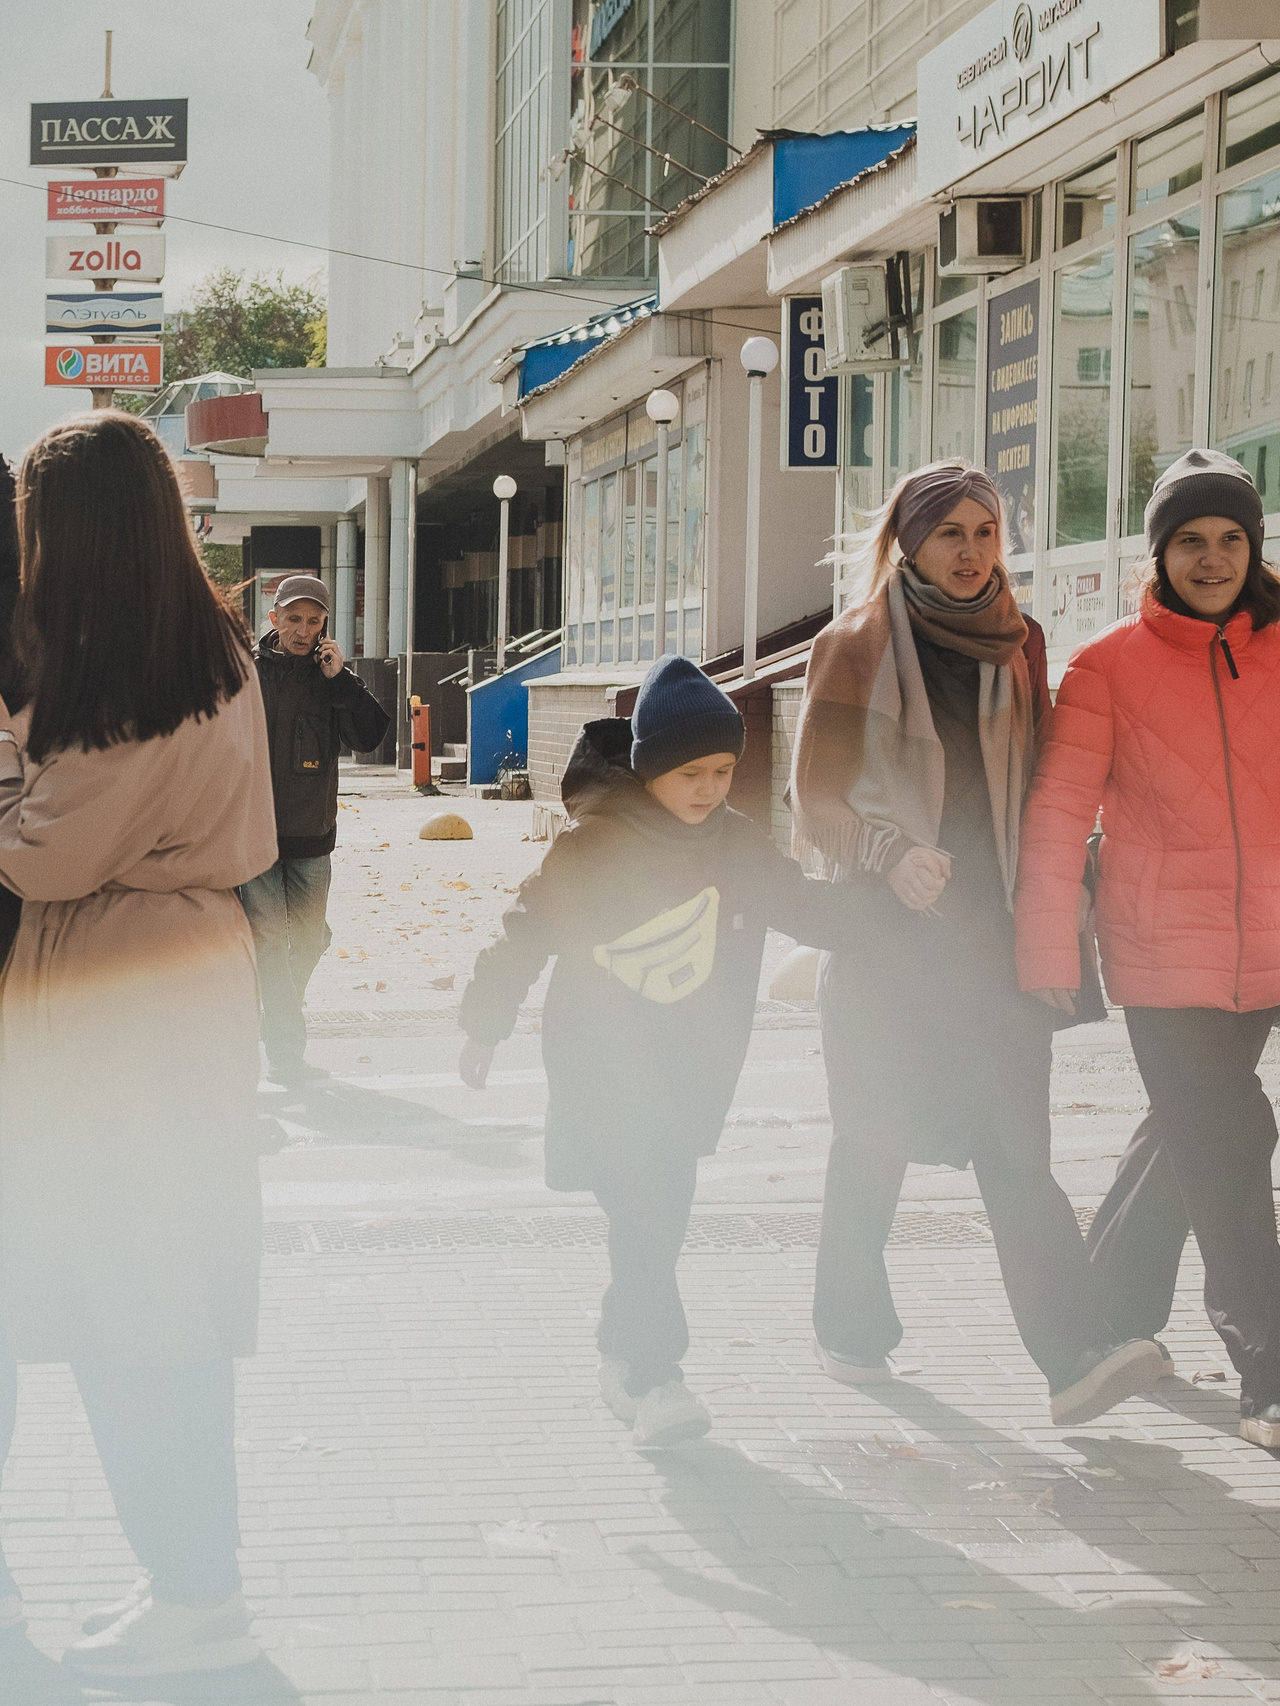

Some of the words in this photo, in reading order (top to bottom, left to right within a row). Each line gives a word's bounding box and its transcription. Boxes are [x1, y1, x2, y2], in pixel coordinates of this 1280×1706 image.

[1037, 0, 1082, 32] МАГАЗИ
[956, 21, 1100, 149] ЧАРОИТ
[40, 115, 175, 143] ПАССАЖ
[56, 185, 159, 206] Леонардо
[68, 242, 142, 271] zolla
[999, 302, 1035, 346] ЗАПИСЬ
[86, 353, 150, 374] ВИТА
[996, 354, 1038, 392] ВИДЕОКАССЕ
[86, 374, 151, 383] ЭКСПРЕСС
[799, 307, 826, 459] ФОТО
[992, 410, 1001, 435] НА
